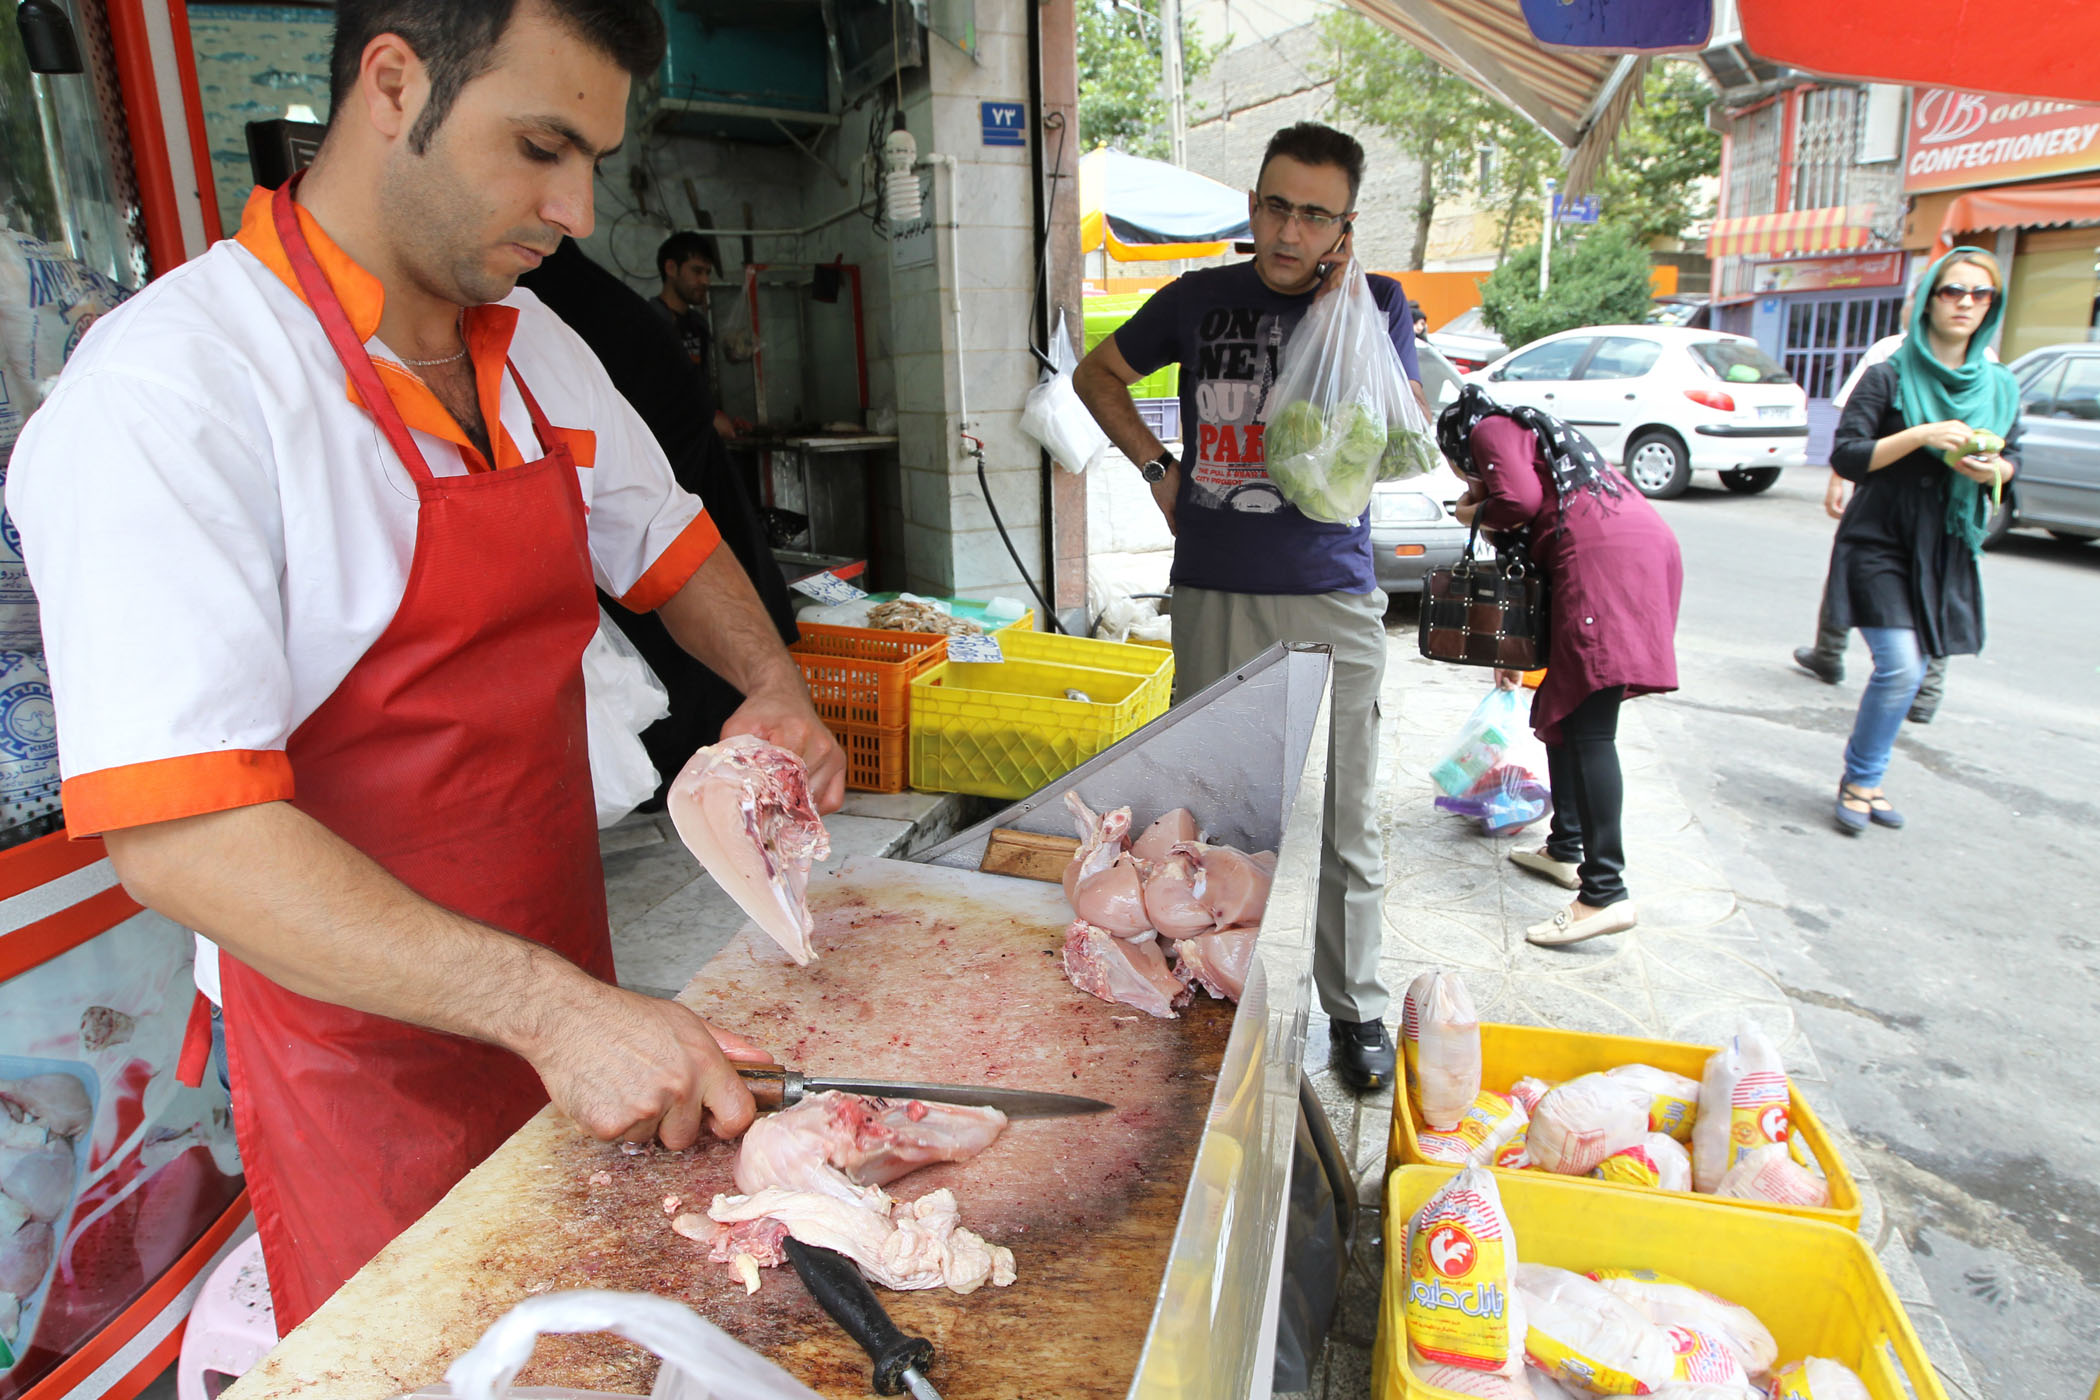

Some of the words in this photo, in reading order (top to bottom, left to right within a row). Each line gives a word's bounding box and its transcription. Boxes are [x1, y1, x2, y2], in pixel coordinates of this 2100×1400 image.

[991, 107, 1016, 127] ۷۳
[1909, 122, 2100, 176] CONFECTIONERY
[1202, 307, 1264, 341] ON
[1198, 342, 1258, 381] NE
[1408, 1278, 1460, 1311] طیور
